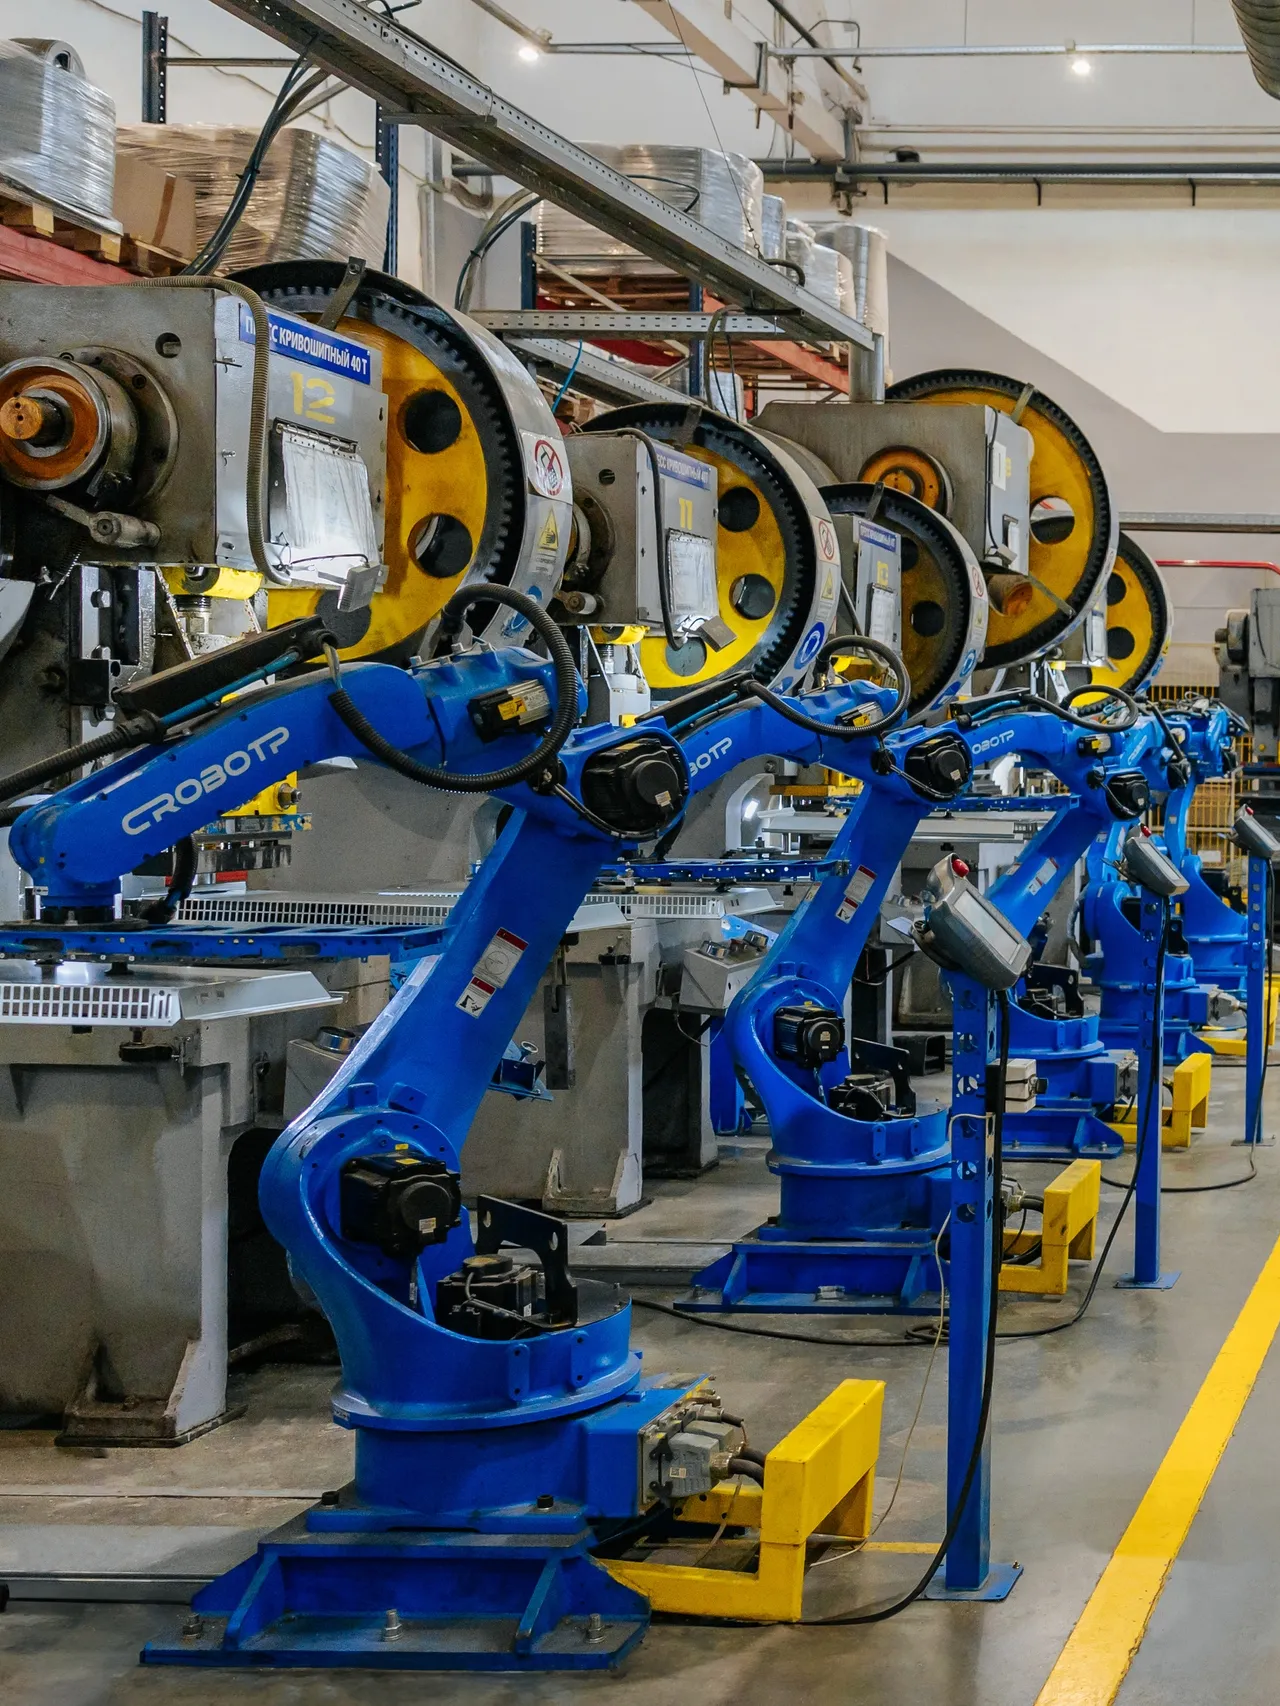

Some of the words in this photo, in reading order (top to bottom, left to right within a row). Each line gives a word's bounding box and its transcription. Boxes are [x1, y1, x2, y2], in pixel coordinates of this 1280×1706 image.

[279, 328, 350, 369] КРИВОШИПНЫЙ
[350, 355, 361, 373] 40
[290, 371, 336, 425] 12
[678, 497, 693, 531] 11
[688, 737, 733, 778] BOTP
[971, 729, 1015, 755] OBOTP
[121, 726, 290, 836] CROBOTP
